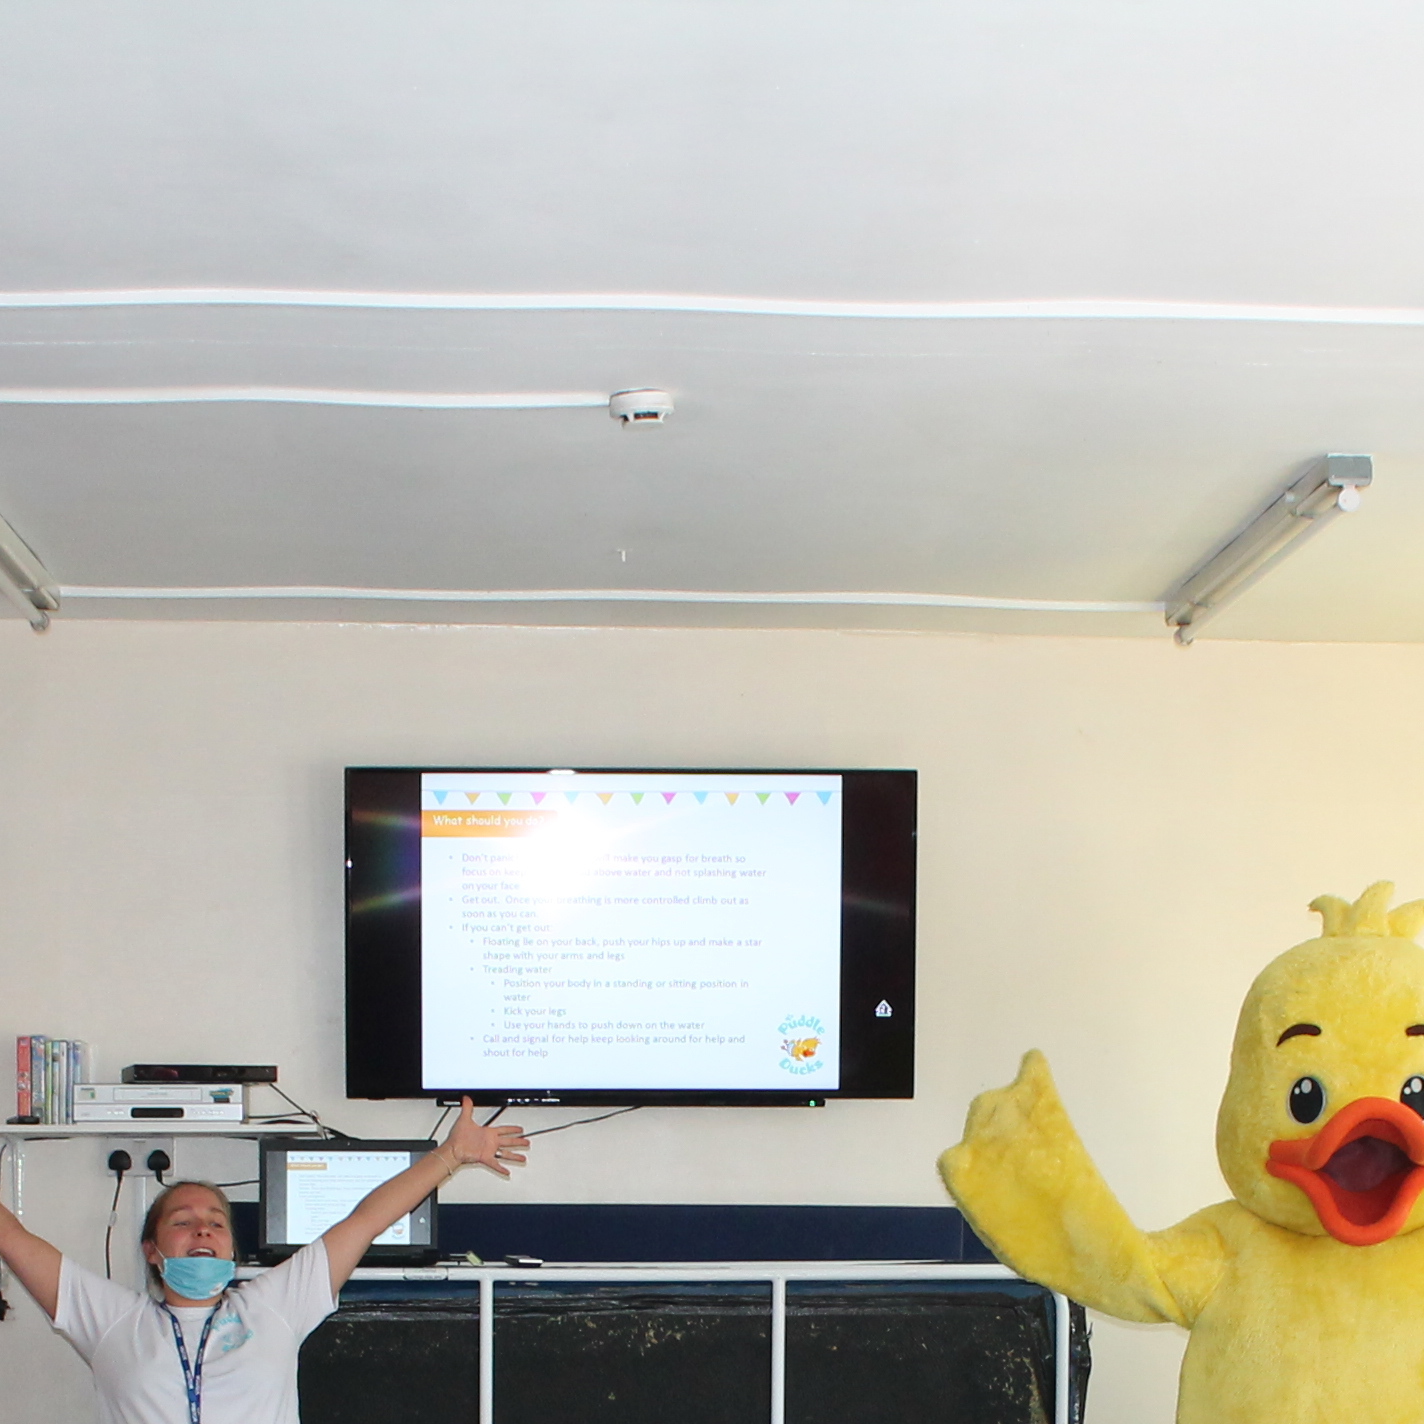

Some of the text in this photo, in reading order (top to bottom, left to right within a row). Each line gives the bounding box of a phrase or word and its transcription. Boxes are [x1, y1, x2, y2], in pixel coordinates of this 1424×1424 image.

[433, 815, 545, 828] What should you do?
[462, 853, 488, 862] Don't
[613, 853, 639, 863] make
[640, 855, 659, 864] you
[661, 855, 683, 864] gasp
[685, 853, 699, 863] for
[701, 853, 732, 863] breath
[735, 855, 746, 863] so
[461, 867, 487, 876] focus
[593, 867, 623, 877] above
[624, 868, 651, 877] water
[654, 867, 672, 877] and
[675, 868, 691, 877] not
[693, 867, 737, 878] splashing
[739, 868, 767, 877] water
[461, 882, 474, 890] on
[475, 882, 499, 892] your
[461, 895, 479, 904] Get
[481, 896, 500, 904] out.
[505, 895, 531, 904] Once
[556, 895, 602, 906] breathing
[604, 895, 612, 904] is
[641, 895, 690, 904] controlled
[692, 895, 718, 905] climb
[720, 896, 737, 905] out
[738, 897, 749, 905] as
[461, 910, 485, 918] soon
[487, 910, 497, 918] as
[499, 910, 517, 920] you
[462, 922, 469, 932] If
[470, 924, 488, 933] you
[490, 922, 514, 932] can't
[516, 924, 532, 934] get
[483, 936, 520, 947] Floating
[523, 936, 534, 946] lie
[536, 938, 549, 946] on
[551, 938, 573, 948] your
[575, 937, 599, 947] back,
[602, 937, 626, 948] push
[627, 938, 650, 948] your
[651, 937, 671, 948] hips
[673, 939, 686, 948] up
[688, 937, 706, 946] and
[708, 937, 734, 946] make
[744, 938, 763, 946] star
[482, 950, 625, 962] shape with your arms and legs
[482, 964, 553, 975] Treading water
[503, 978, 750, 990] Position your body in a standing or sitting position in
[503, 993, 531, 1002] water
[503, 1006, 567, 1017] Kick your legs
[503, 1020, 705, 1031] Use your hands to push down on the water
[777, 1015, 826, 1036] Puddle
[482, 1034, 746, 1045] Call and signal for help keep looking around for help and
[483, 1048, 549, 1059] shout for help
[778, 1058, 824, 1076] Ducks
